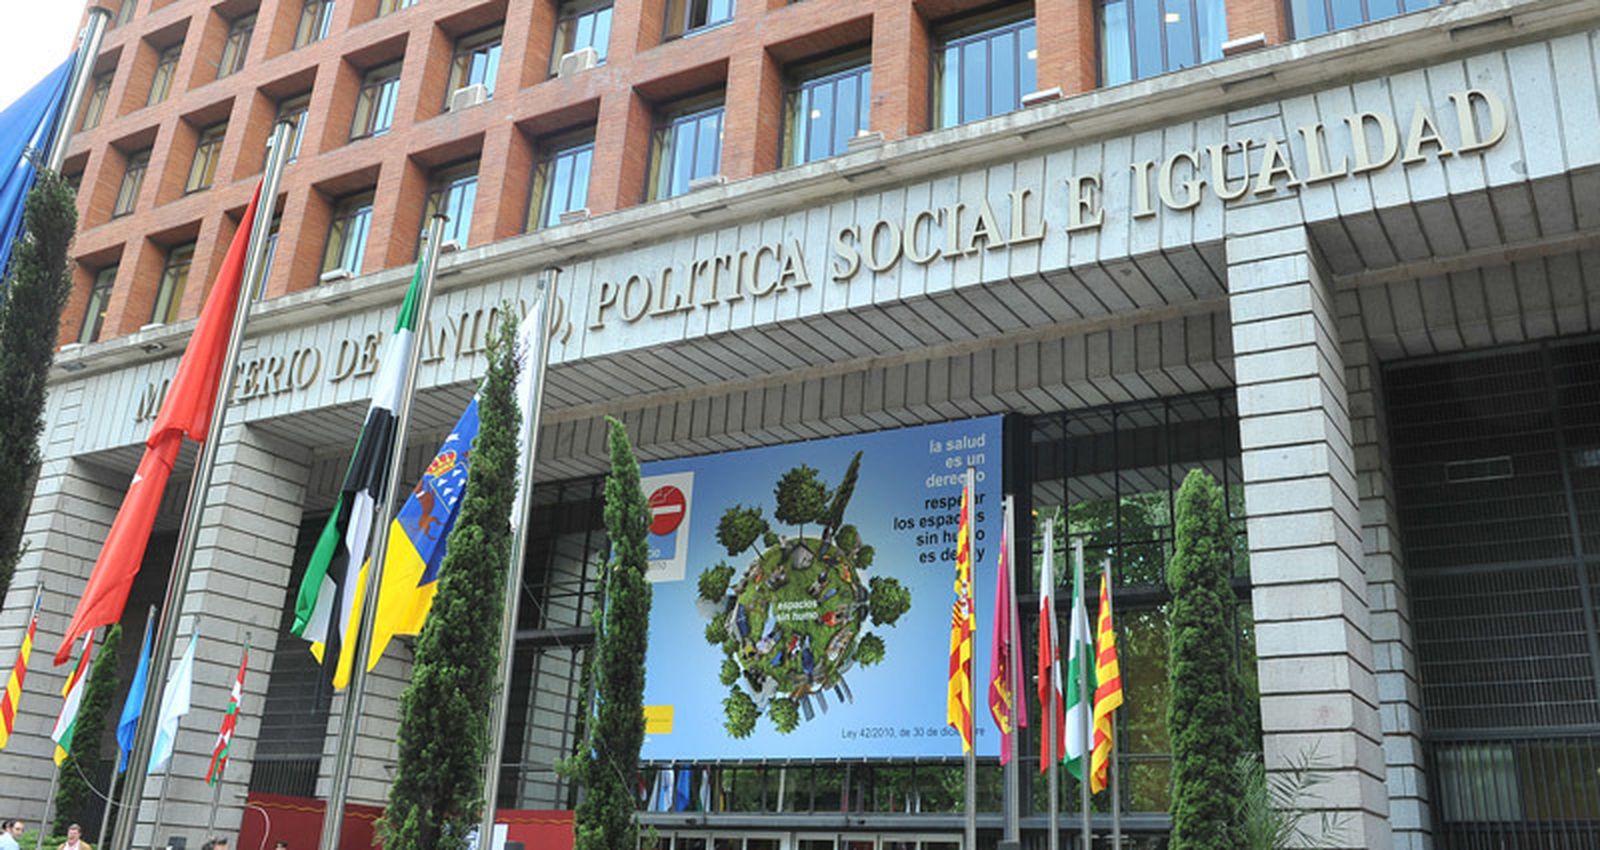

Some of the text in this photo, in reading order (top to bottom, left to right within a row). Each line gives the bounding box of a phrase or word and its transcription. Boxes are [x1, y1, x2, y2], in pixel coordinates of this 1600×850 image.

[328, 331, 383, 384] DE
[589, 239, 812, 331] POLITICA
[832, 188, 1047, 283] SOCIAL
[1065, 173, 1105, 234] E
[1130, 88, 1509, 220] IGUALDAD
[929, 433, 985, 453] la salud
[945, 453, 985, 469] es un
[926, 470, 985, 488] dereco
[893, 510, 985, 531] los espacs
[916, 529, 985, 547] sin huo
[919, 551, 936, 563] es
[841, 728, 857, 740] Ley
[913, 727, 925, 737] 30
[926, 727, 938, 737] de
